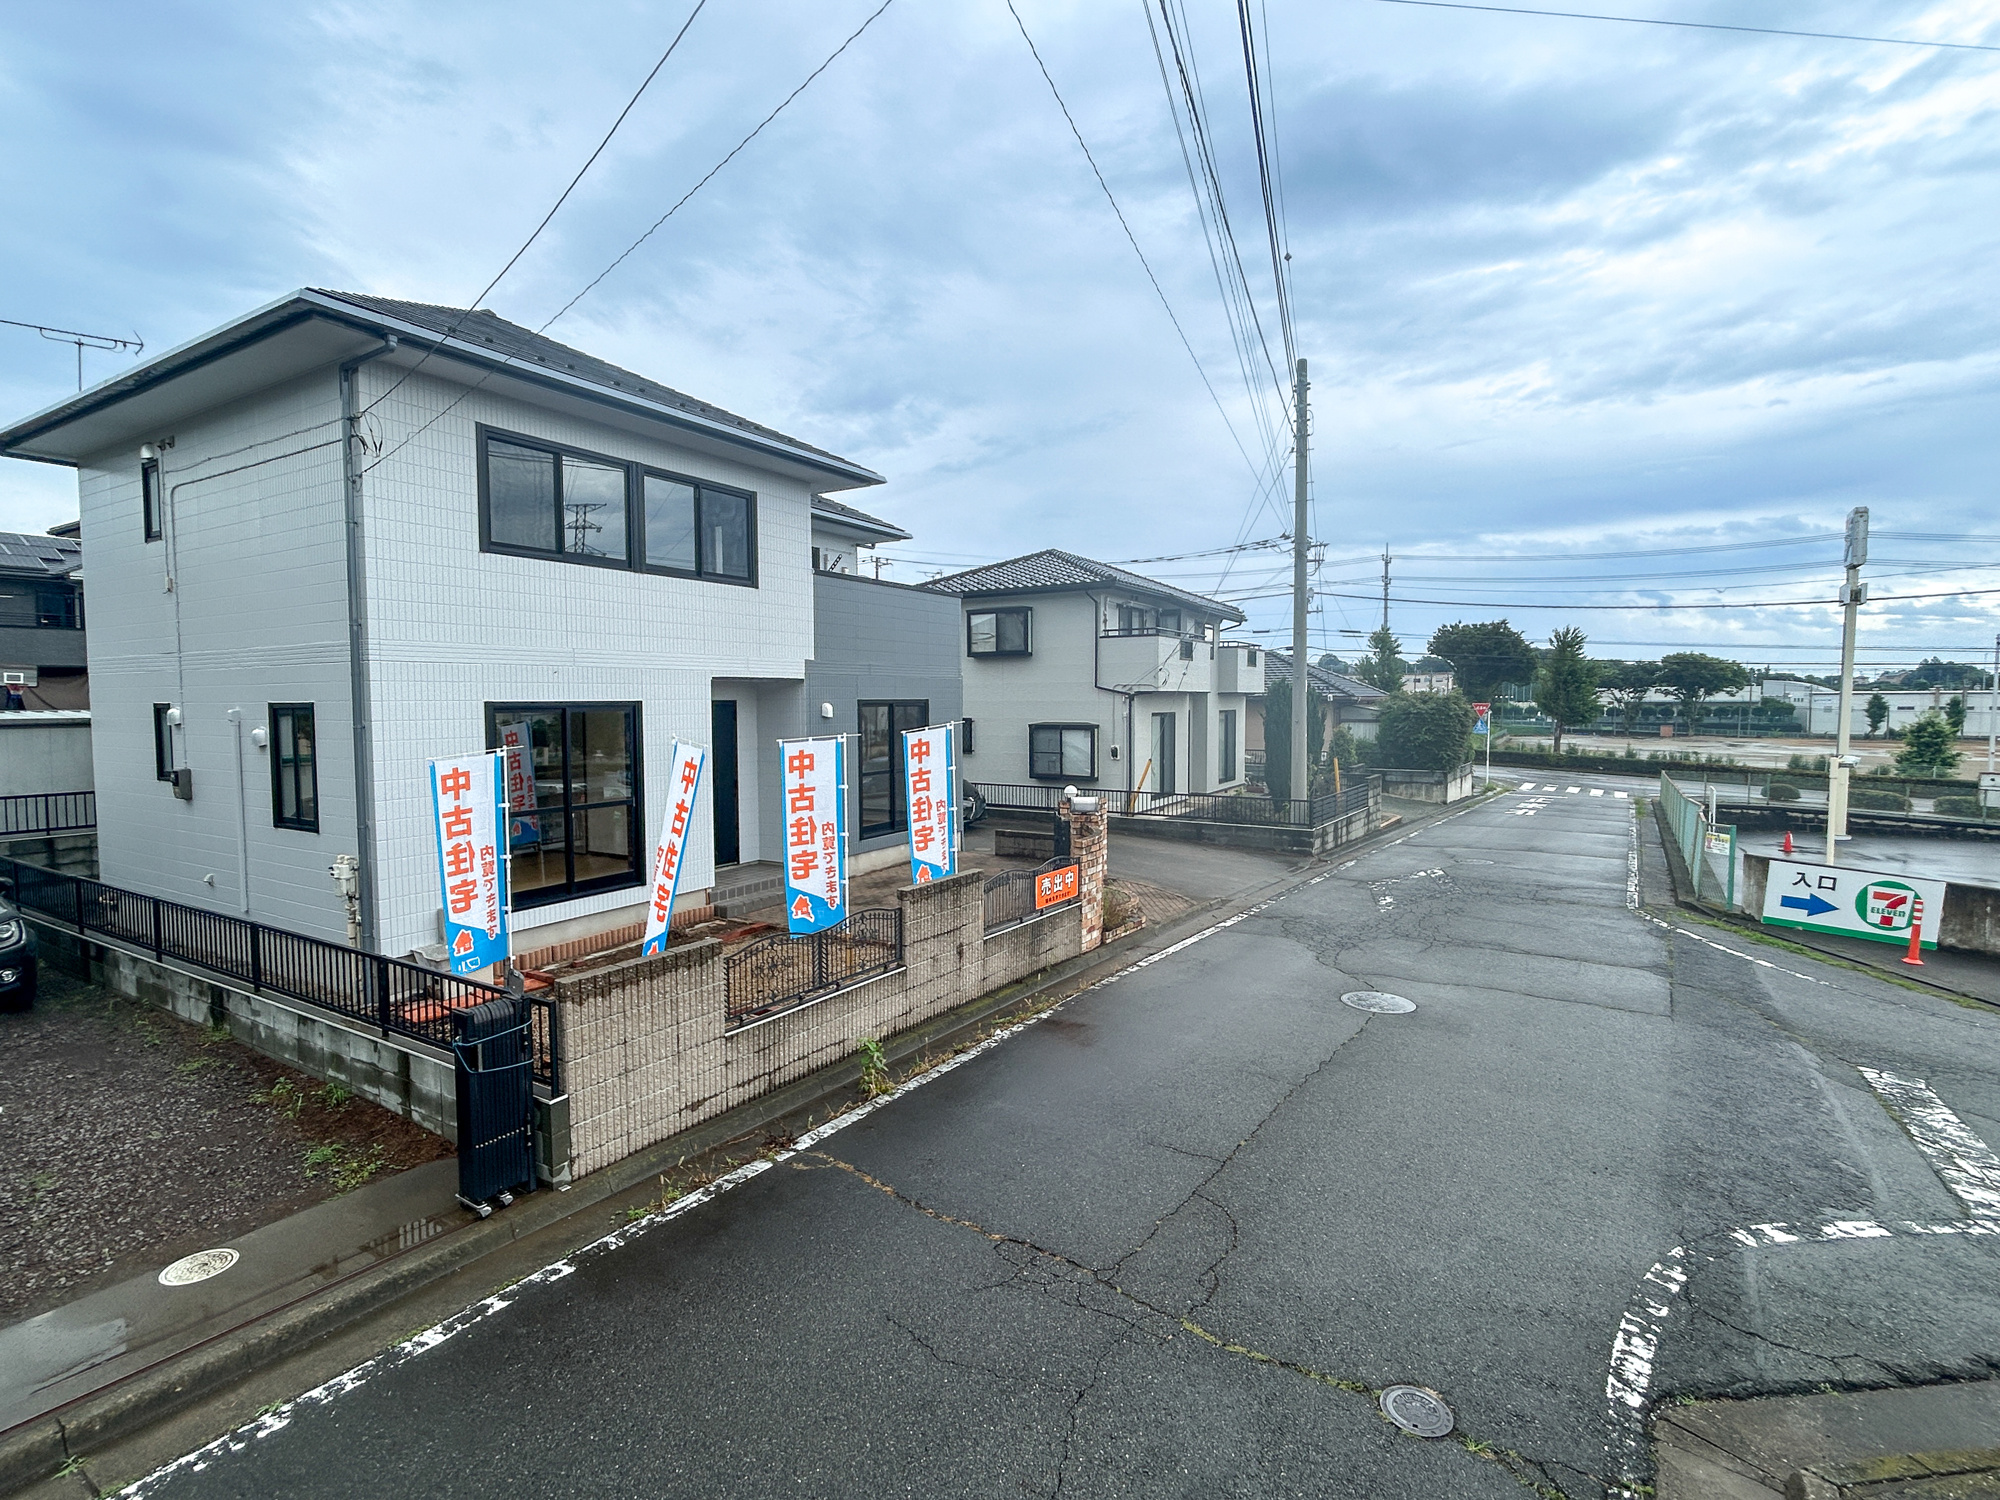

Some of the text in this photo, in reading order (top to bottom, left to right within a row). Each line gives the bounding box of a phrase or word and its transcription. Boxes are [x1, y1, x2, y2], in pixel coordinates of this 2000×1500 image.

[654, 757, 698, 923] 中古住宅
[1041, 870, 1074, 896] 売出中
[1792, 872, 1837, 891] 入口
[1873, 891, 1908, 926] 7
